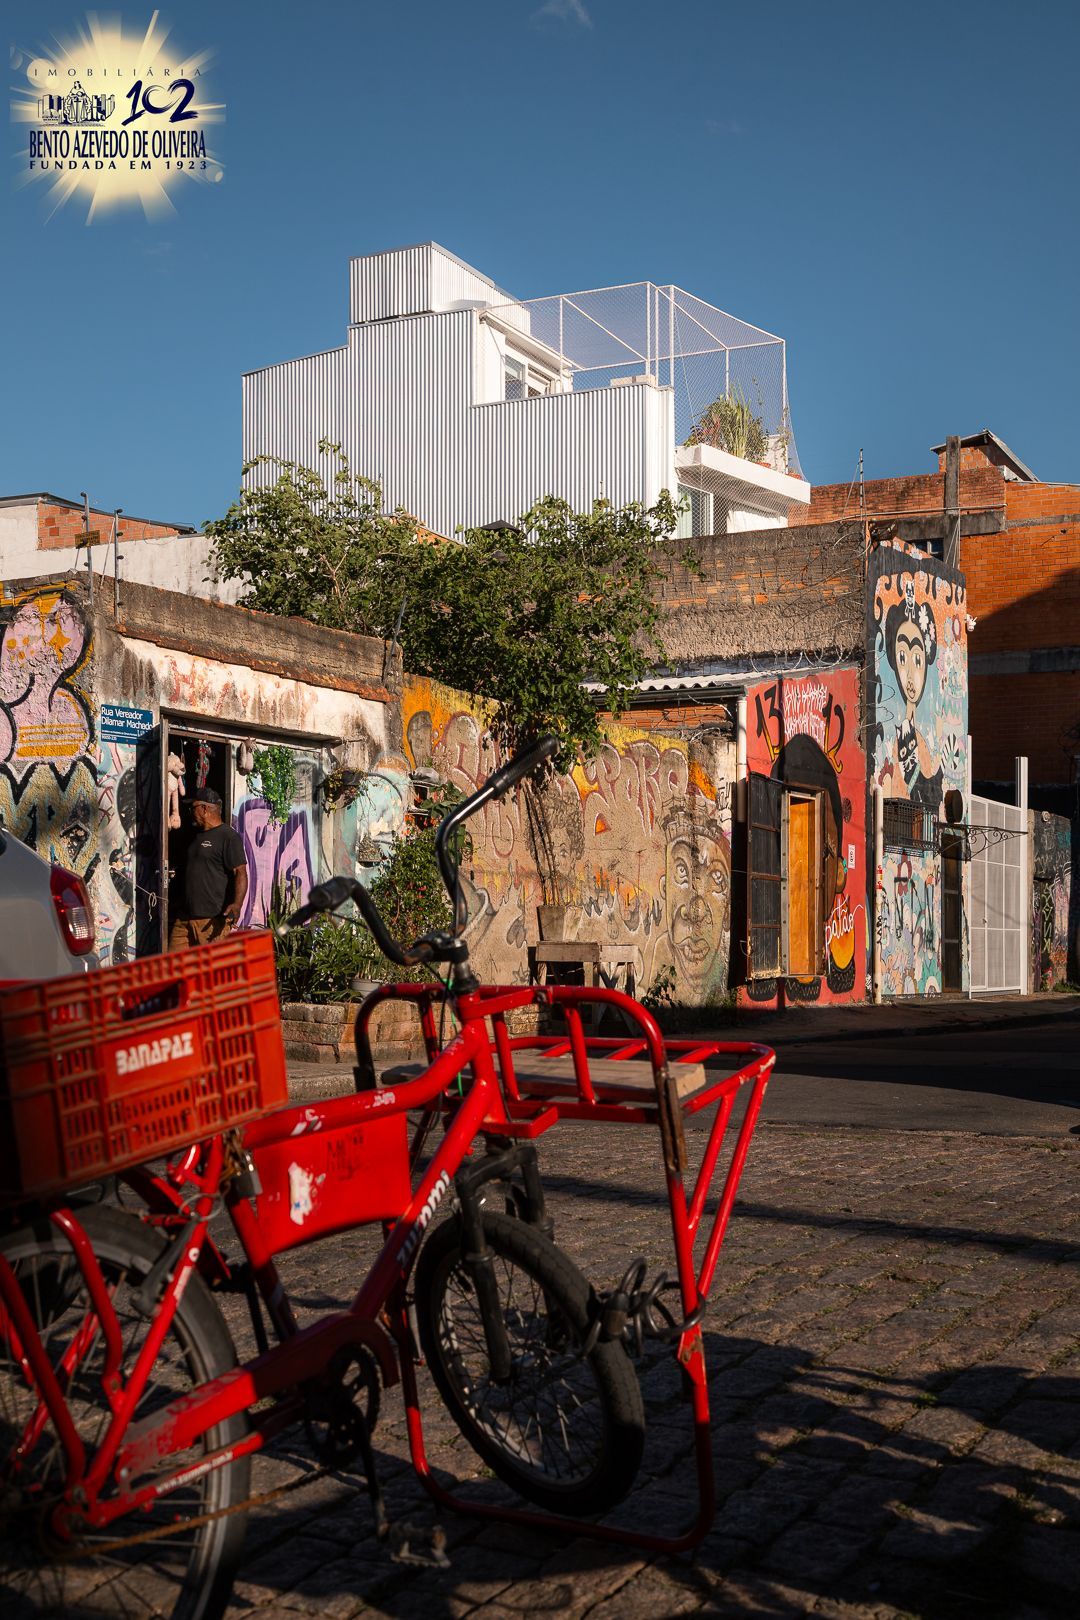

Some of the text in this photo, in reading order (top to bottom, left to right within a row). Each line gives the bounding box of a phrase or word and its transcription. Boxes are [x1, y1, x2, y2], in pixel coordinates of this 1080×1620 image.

[101, 706, 143, 720] Rua Vereador
[101, 716, 153, 730] Dilamar Machado
[115, 1031, 194, 1076] BANAPAZ
